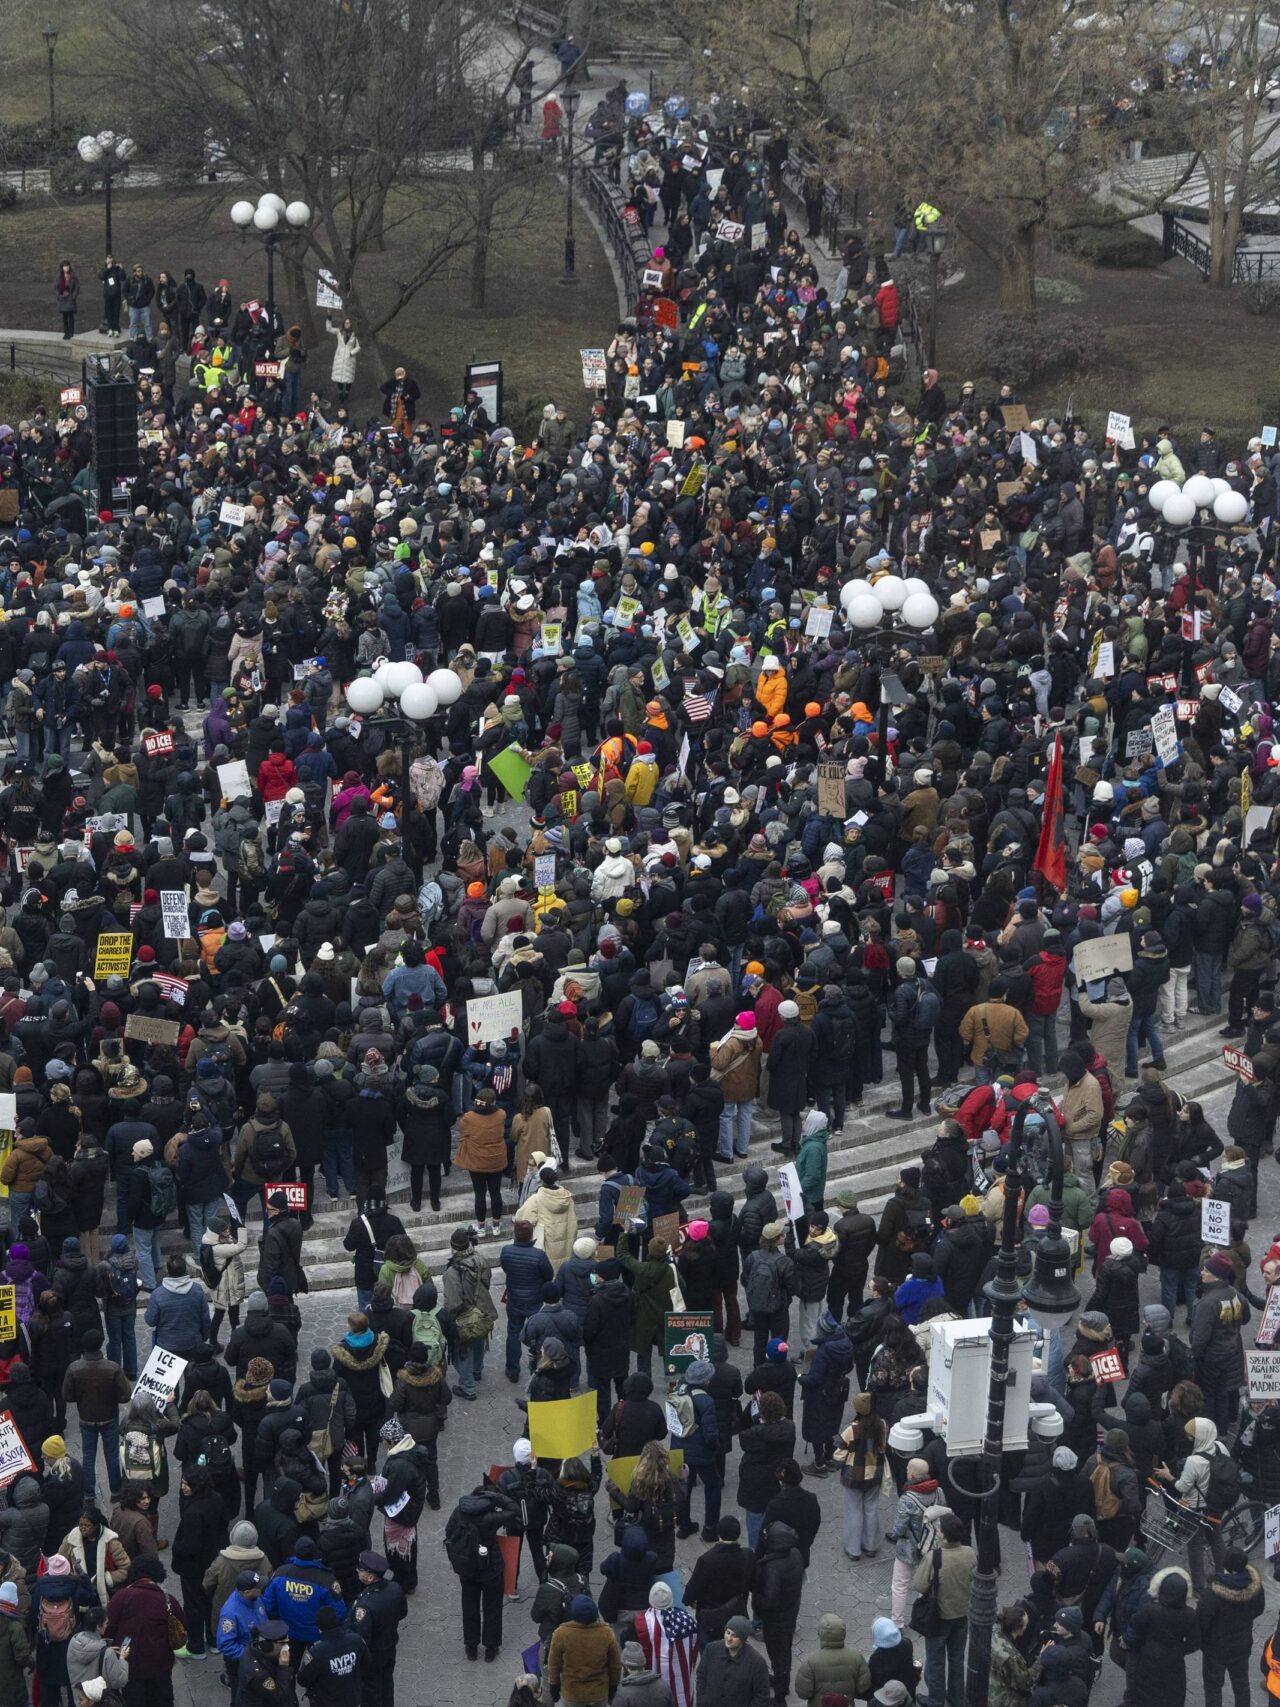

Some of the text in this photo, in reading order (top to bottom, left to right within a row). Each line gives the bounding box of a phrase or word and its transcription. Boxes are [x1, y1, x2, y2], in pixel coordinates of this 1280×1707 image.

[256, 364, 278, 374] NO ICE!
[61, 393, 70, 401] NO
[146, 735, 173, 752] NO ICE!
[162, 893, 186, 907] DEFEND
[99, 935, 132, 947] DROP THE
[97, 946, 131, 956] CHARGES ON
[96, 961, 127, 972] ACTIVISTS!
[1224, 1050, 1254, 1075] NO ICE!
[1208, 1201, 1223, 1210] NO
[1208, 1214, 1223, 1224] NO
[1208, 1226, 1223, 1234] NO
[3, 1315, 9, 1326] A
[667, 1320, 712, 1328] PASS NY4ALL
[157, 1351, 177, 1369] ICE
[1099, 1354, 1120, 1374] ICE!
[1249, 1355, 1270, 1366] SPEAK
[139, 1373, 175, 1397] AMERICAN
[1266, 1526, 1278, 1540] OF
[285, 1580, 314, 1596] NYPD
[329, 1651, 357, 1671] NYPD
